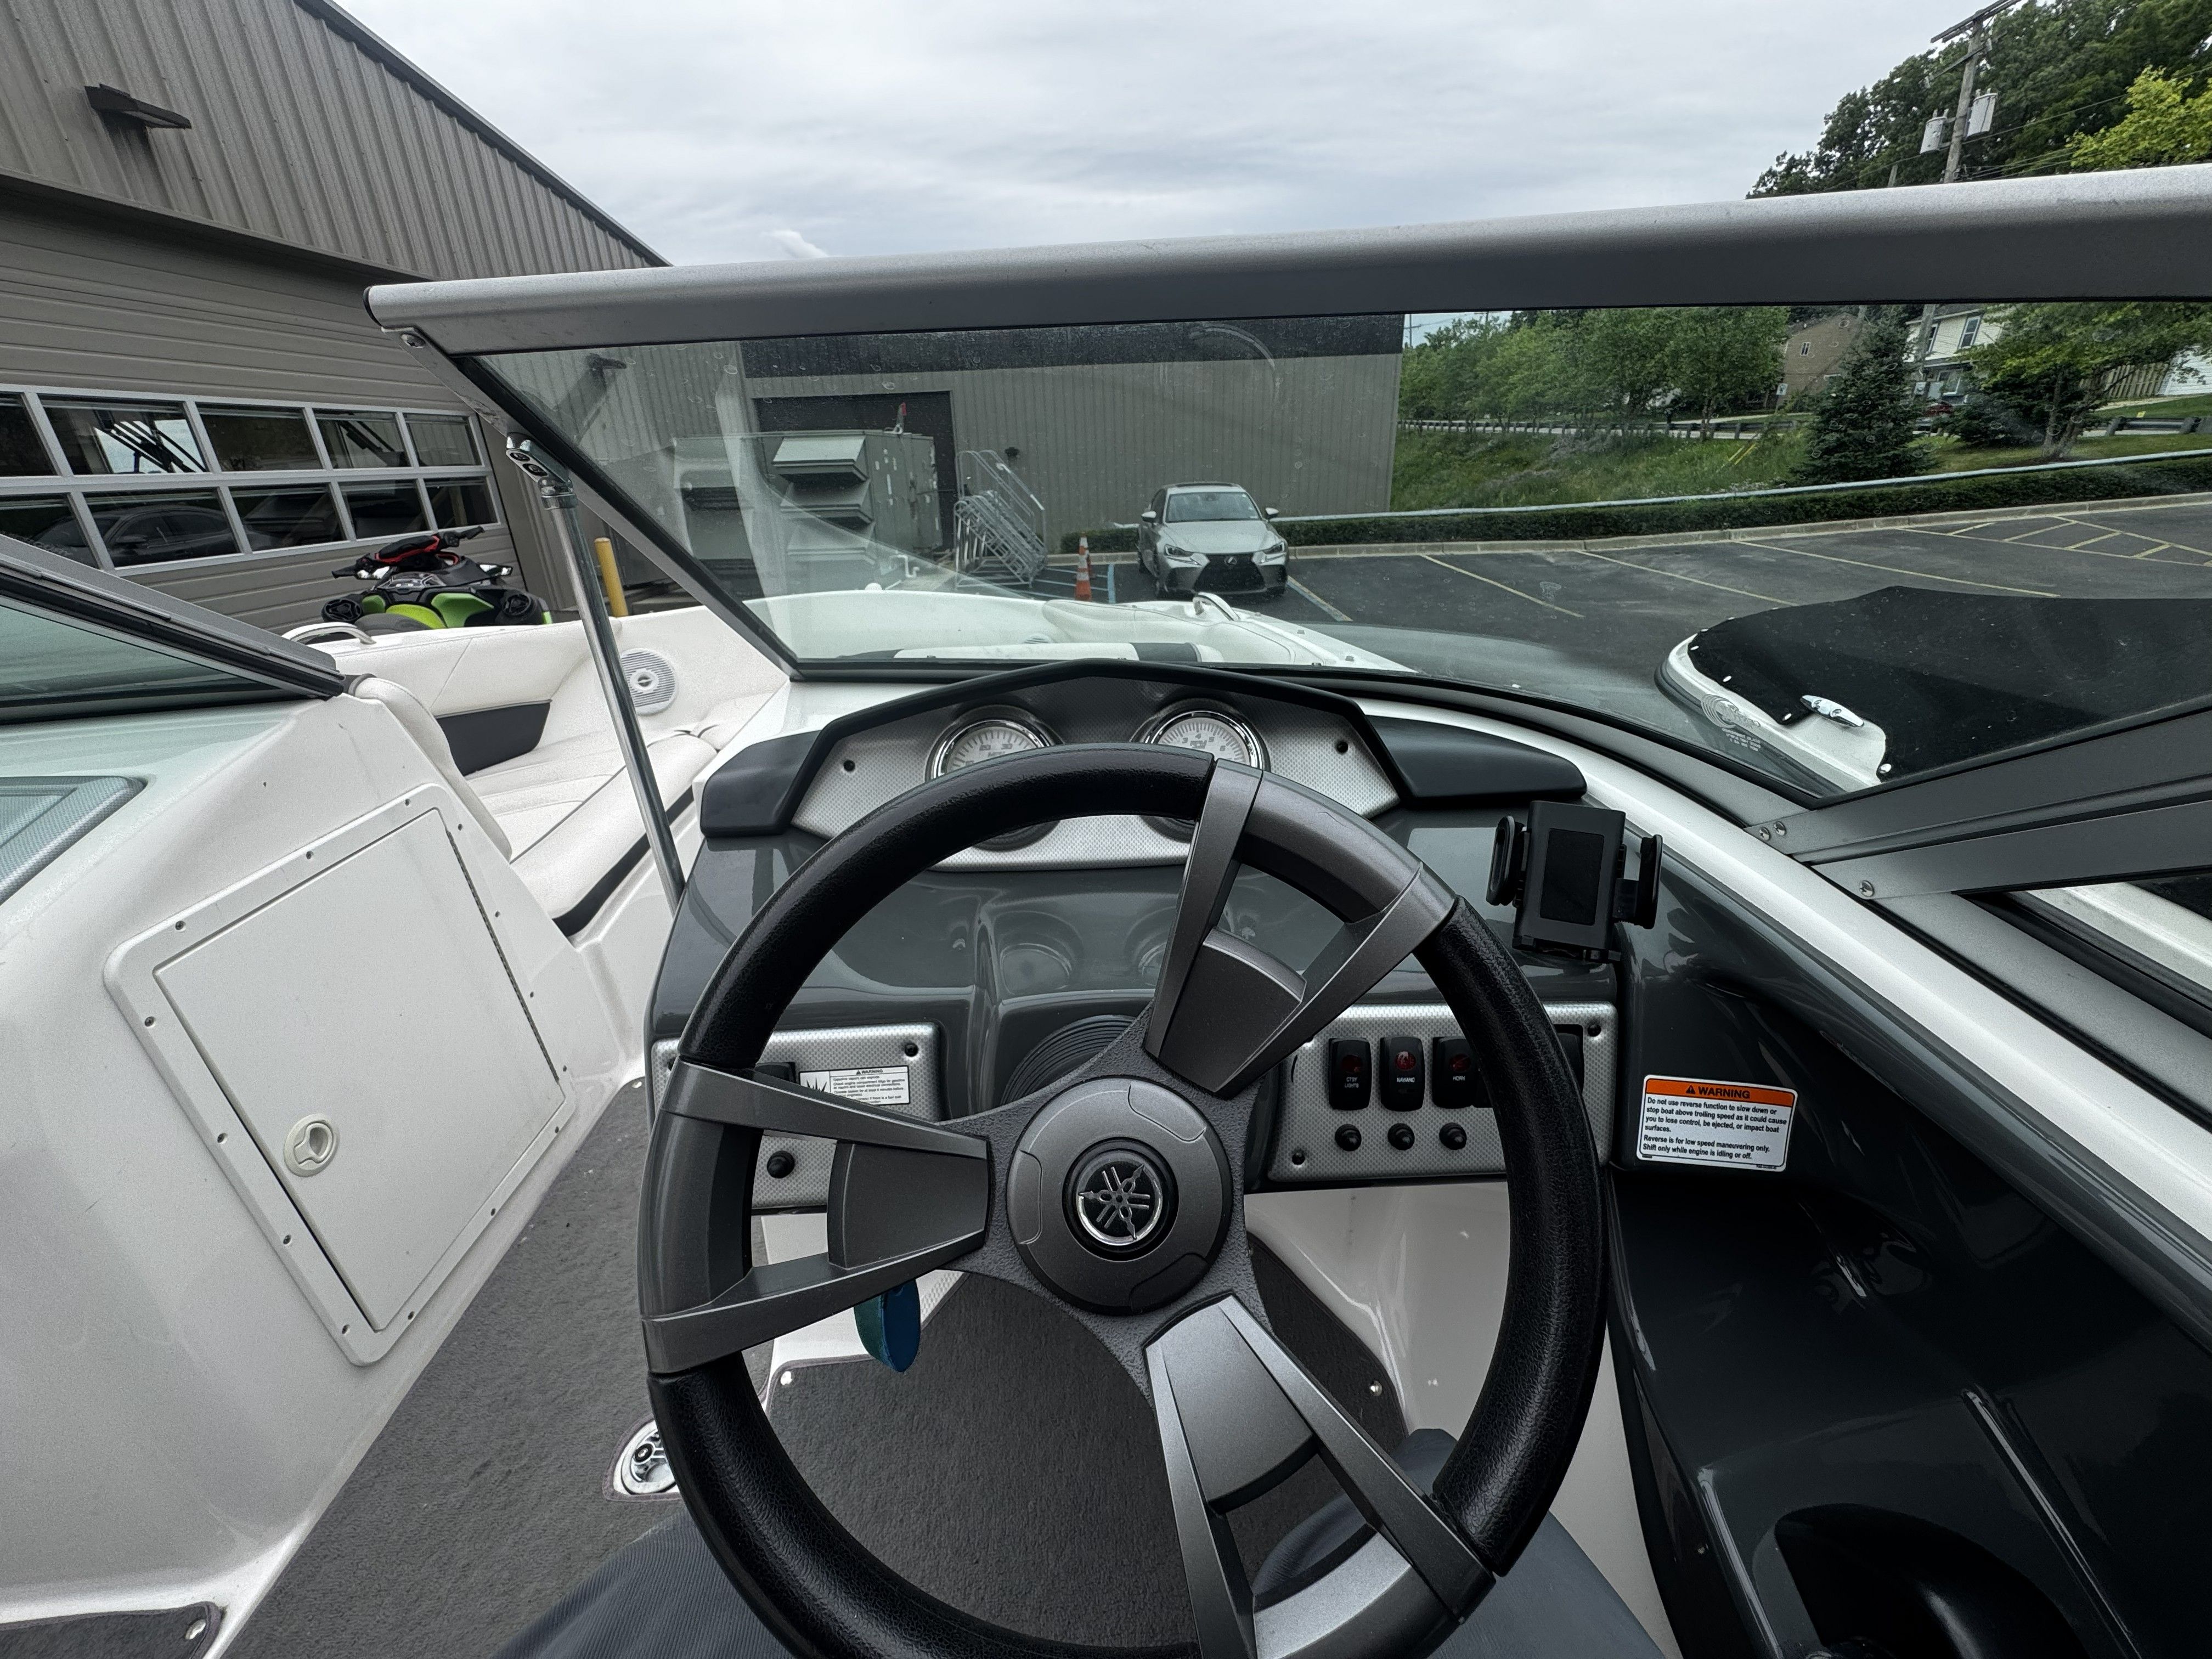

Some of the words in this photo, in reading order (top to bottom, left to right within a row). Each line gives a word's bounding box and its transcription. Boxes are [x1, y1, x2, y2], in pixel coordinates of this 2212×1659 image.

[1699, 1086, 1750, 1099] WARNING
[1703, 1102, 1727, 1110] function
[1695, 1110, 1716, 1120] trolling
[1712, 1121, 1735, 1130] ejected,
[1744, 1124, 1764, 1132] impact
[1765, 1125, 1779, 1133] boat
[1658, 1145, 1671, 1154] only
[1717, 1150, 1733, 1159] idling
[1717, 1142, 1754, 1152] maneuvering
[1756, 1145, 1770, 1153] only.
